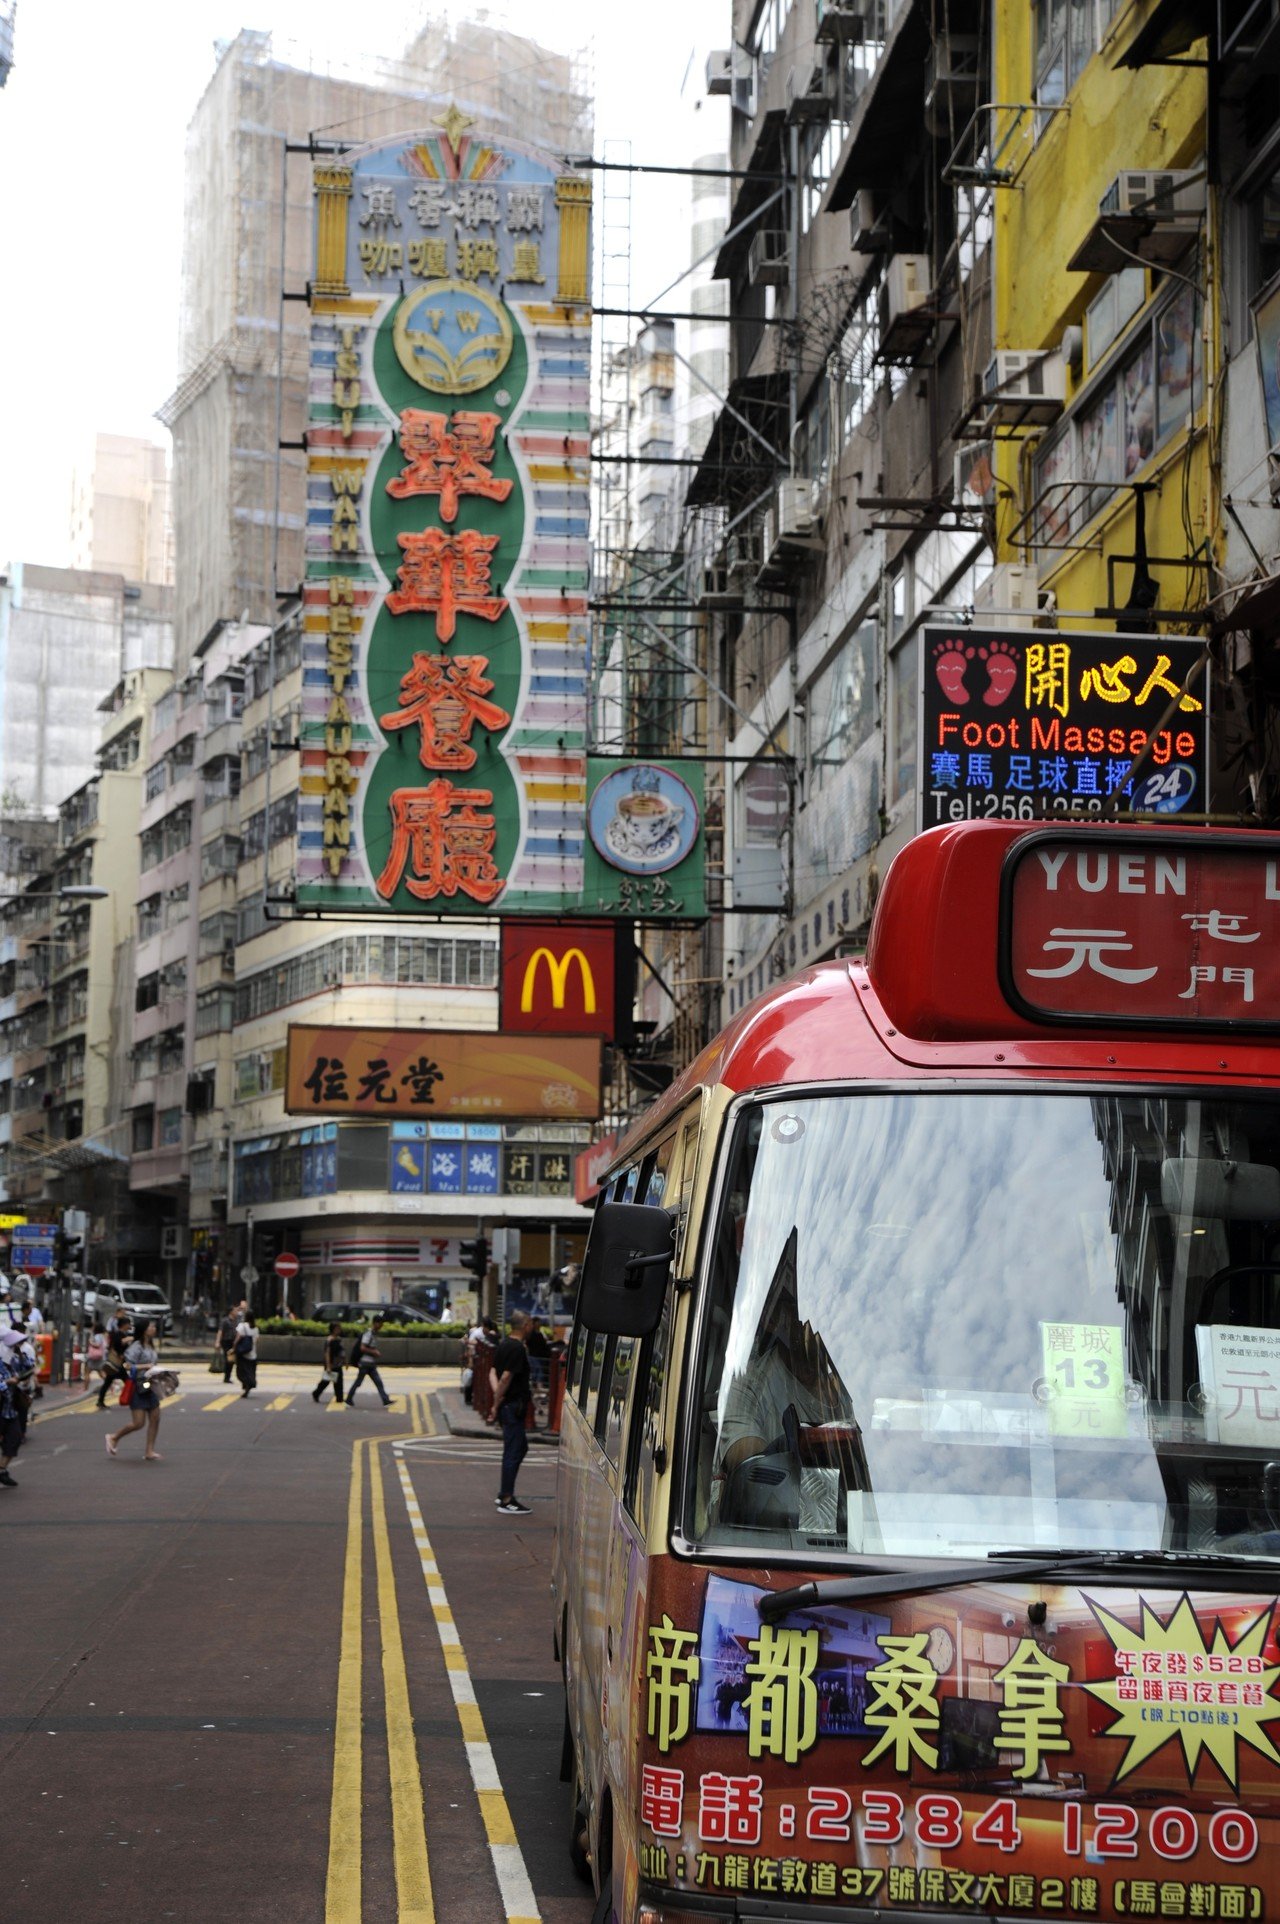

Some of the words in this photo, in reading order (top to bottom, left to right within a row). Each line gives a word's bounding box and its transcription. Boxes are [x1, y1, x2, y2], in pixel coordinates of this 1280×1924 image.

[336, 325, 362, 438] TSUI
[331, 467, 364, 551] WAH
[1024, 643, 1203, 718] 開心人
[322, 575, 355, 877] RESTAURANT
[939, 714, 1019, 749] Foot
[1031, 717, 1195, 765] Massage
[931, 750, 993, 789] 賽馬
[1143, 769, 1181, 805] 24
[1036, 851, 1187, 895] YUEN
[1026, 927, 1158, 984] 元
[1178, 909, 1261, 1003] 屯門
[1056, 1358, 1109, 1389] 13
[1222, 1369, 1280, 1421] 元
[646, 1614, 1070, 1779] 帝都桑拿
[1063, 1802, 1260, 1863] 1200
